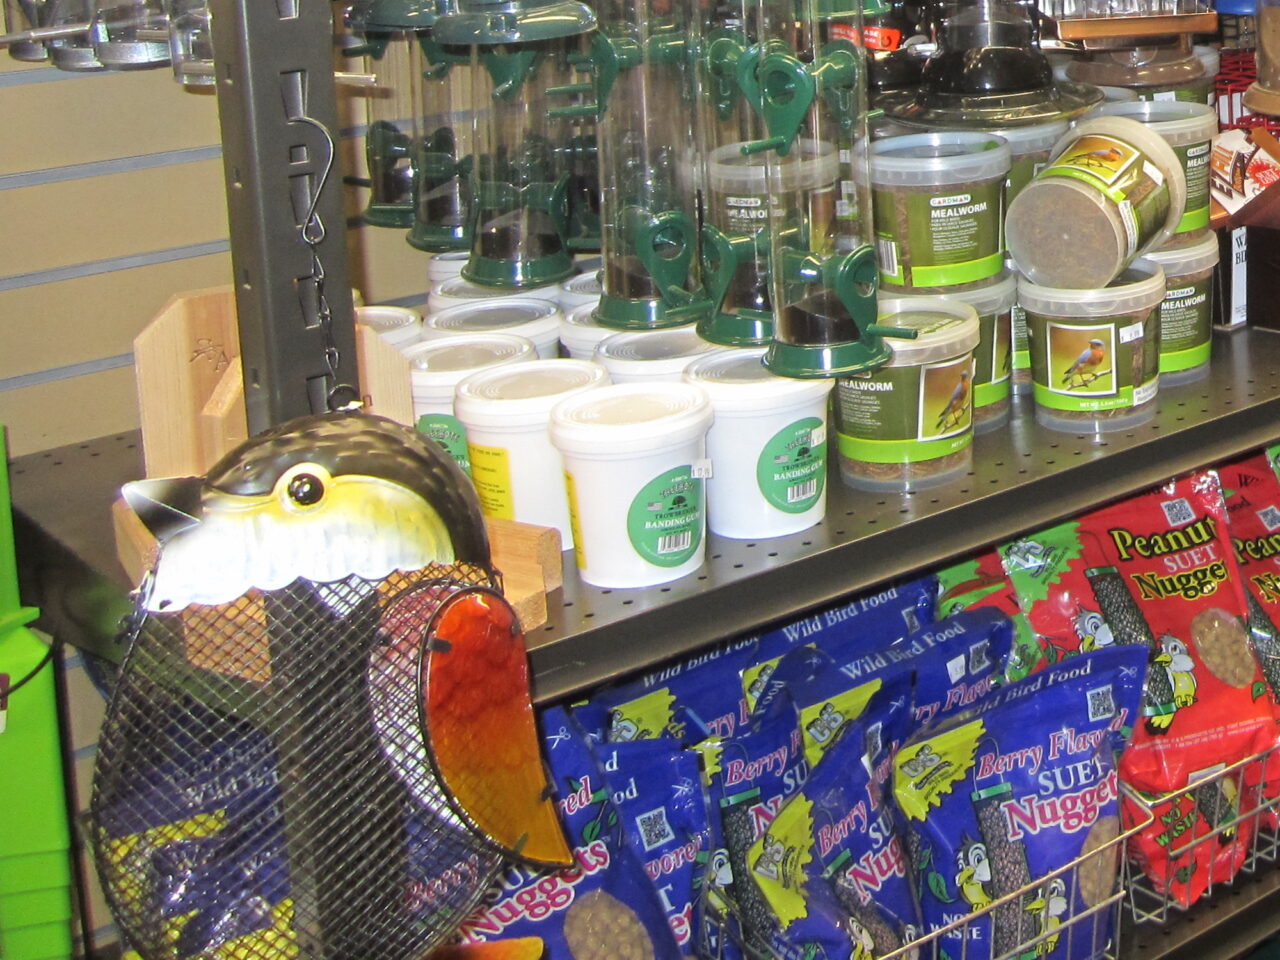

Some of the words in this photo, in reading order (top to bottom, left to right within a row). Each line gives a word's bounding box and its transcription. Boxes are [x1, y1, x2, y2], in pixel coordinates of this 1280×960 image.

[930, 195, 971, 206] GARDMAN
[931, 203, 988, 219] MEALWORM
[1161, 294, 1206, 310] MEALWORM
[839, 380, 893, 391] MEALWORM
[774, 465, 811, 481] BANDING
[645, 515, 686, 529] BANDING
[1108, 515, 1218, 562] Peanut
[1162, 544, 1218, 574] SUET
[1131, 559, 1228, 601] Nugge
[782, 616, 822, 643] Wild
[824, 601, 857, 627] Bird
[858, 587, 899, 613] Food
[839, 653, 885, 681] Wild
[926, 621, 967, 647] Food
[642, 664, 682, 688] Wild
[1004, 676, 1043, 702] Bird
[1046, 658, 1093, 687] Food
[724, 746, 789, 787] Berry
[975, 744, 1044, 782] Berry
[1037, 753, 1104, 797] SUET
[1001, 767, 1121, 844] Nugget
[1160, 806, 1181, 826] NO
[817, 800, 868, 858] Berry
[459, 840, 611, 948] Nuggets
